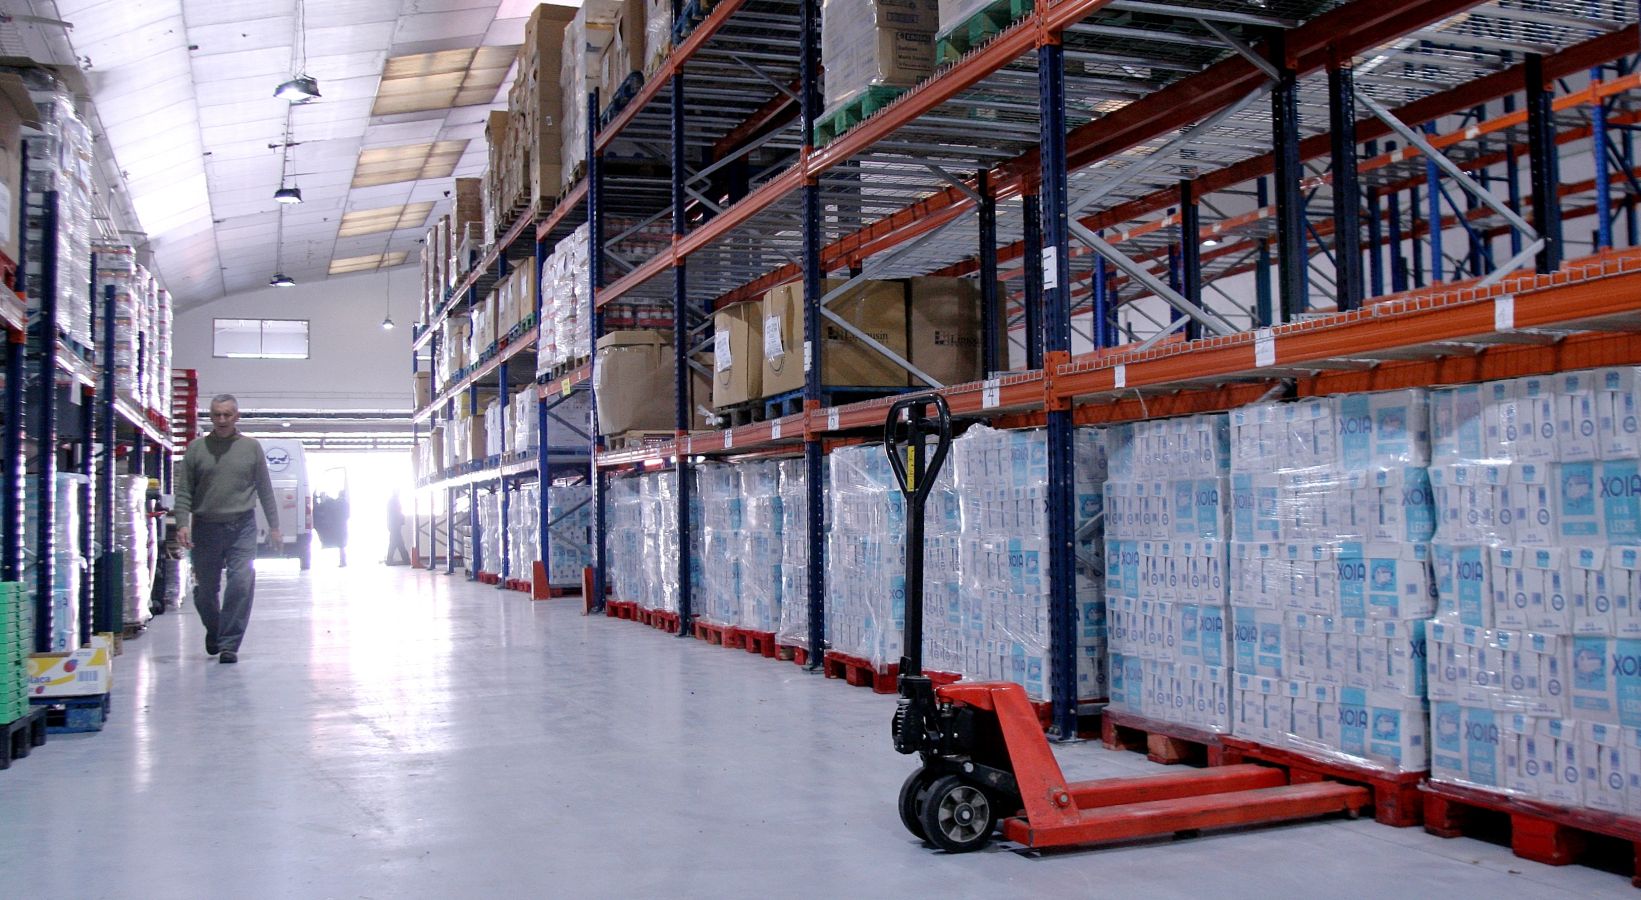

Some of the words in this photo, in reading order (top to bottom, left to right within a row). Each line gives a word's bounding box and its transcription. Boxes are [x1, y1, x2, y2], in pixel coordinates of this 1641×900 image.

[1339, 415, 1372, 435] XOIA
[1195, 489, 1219, 506] XOIA
[1121, 551, 1139, 567] XOIA
[1337, 563, 1366, 582] XOIA
[1457, 560, 1483, 581] XOIA
[1200, 616, 1223, 633] XOIA
[1234, 625, 1257, 644] XOIA
[1338, 706, 1369, 730] XOIA
[1464, 720, 1499, 746] XOIA
